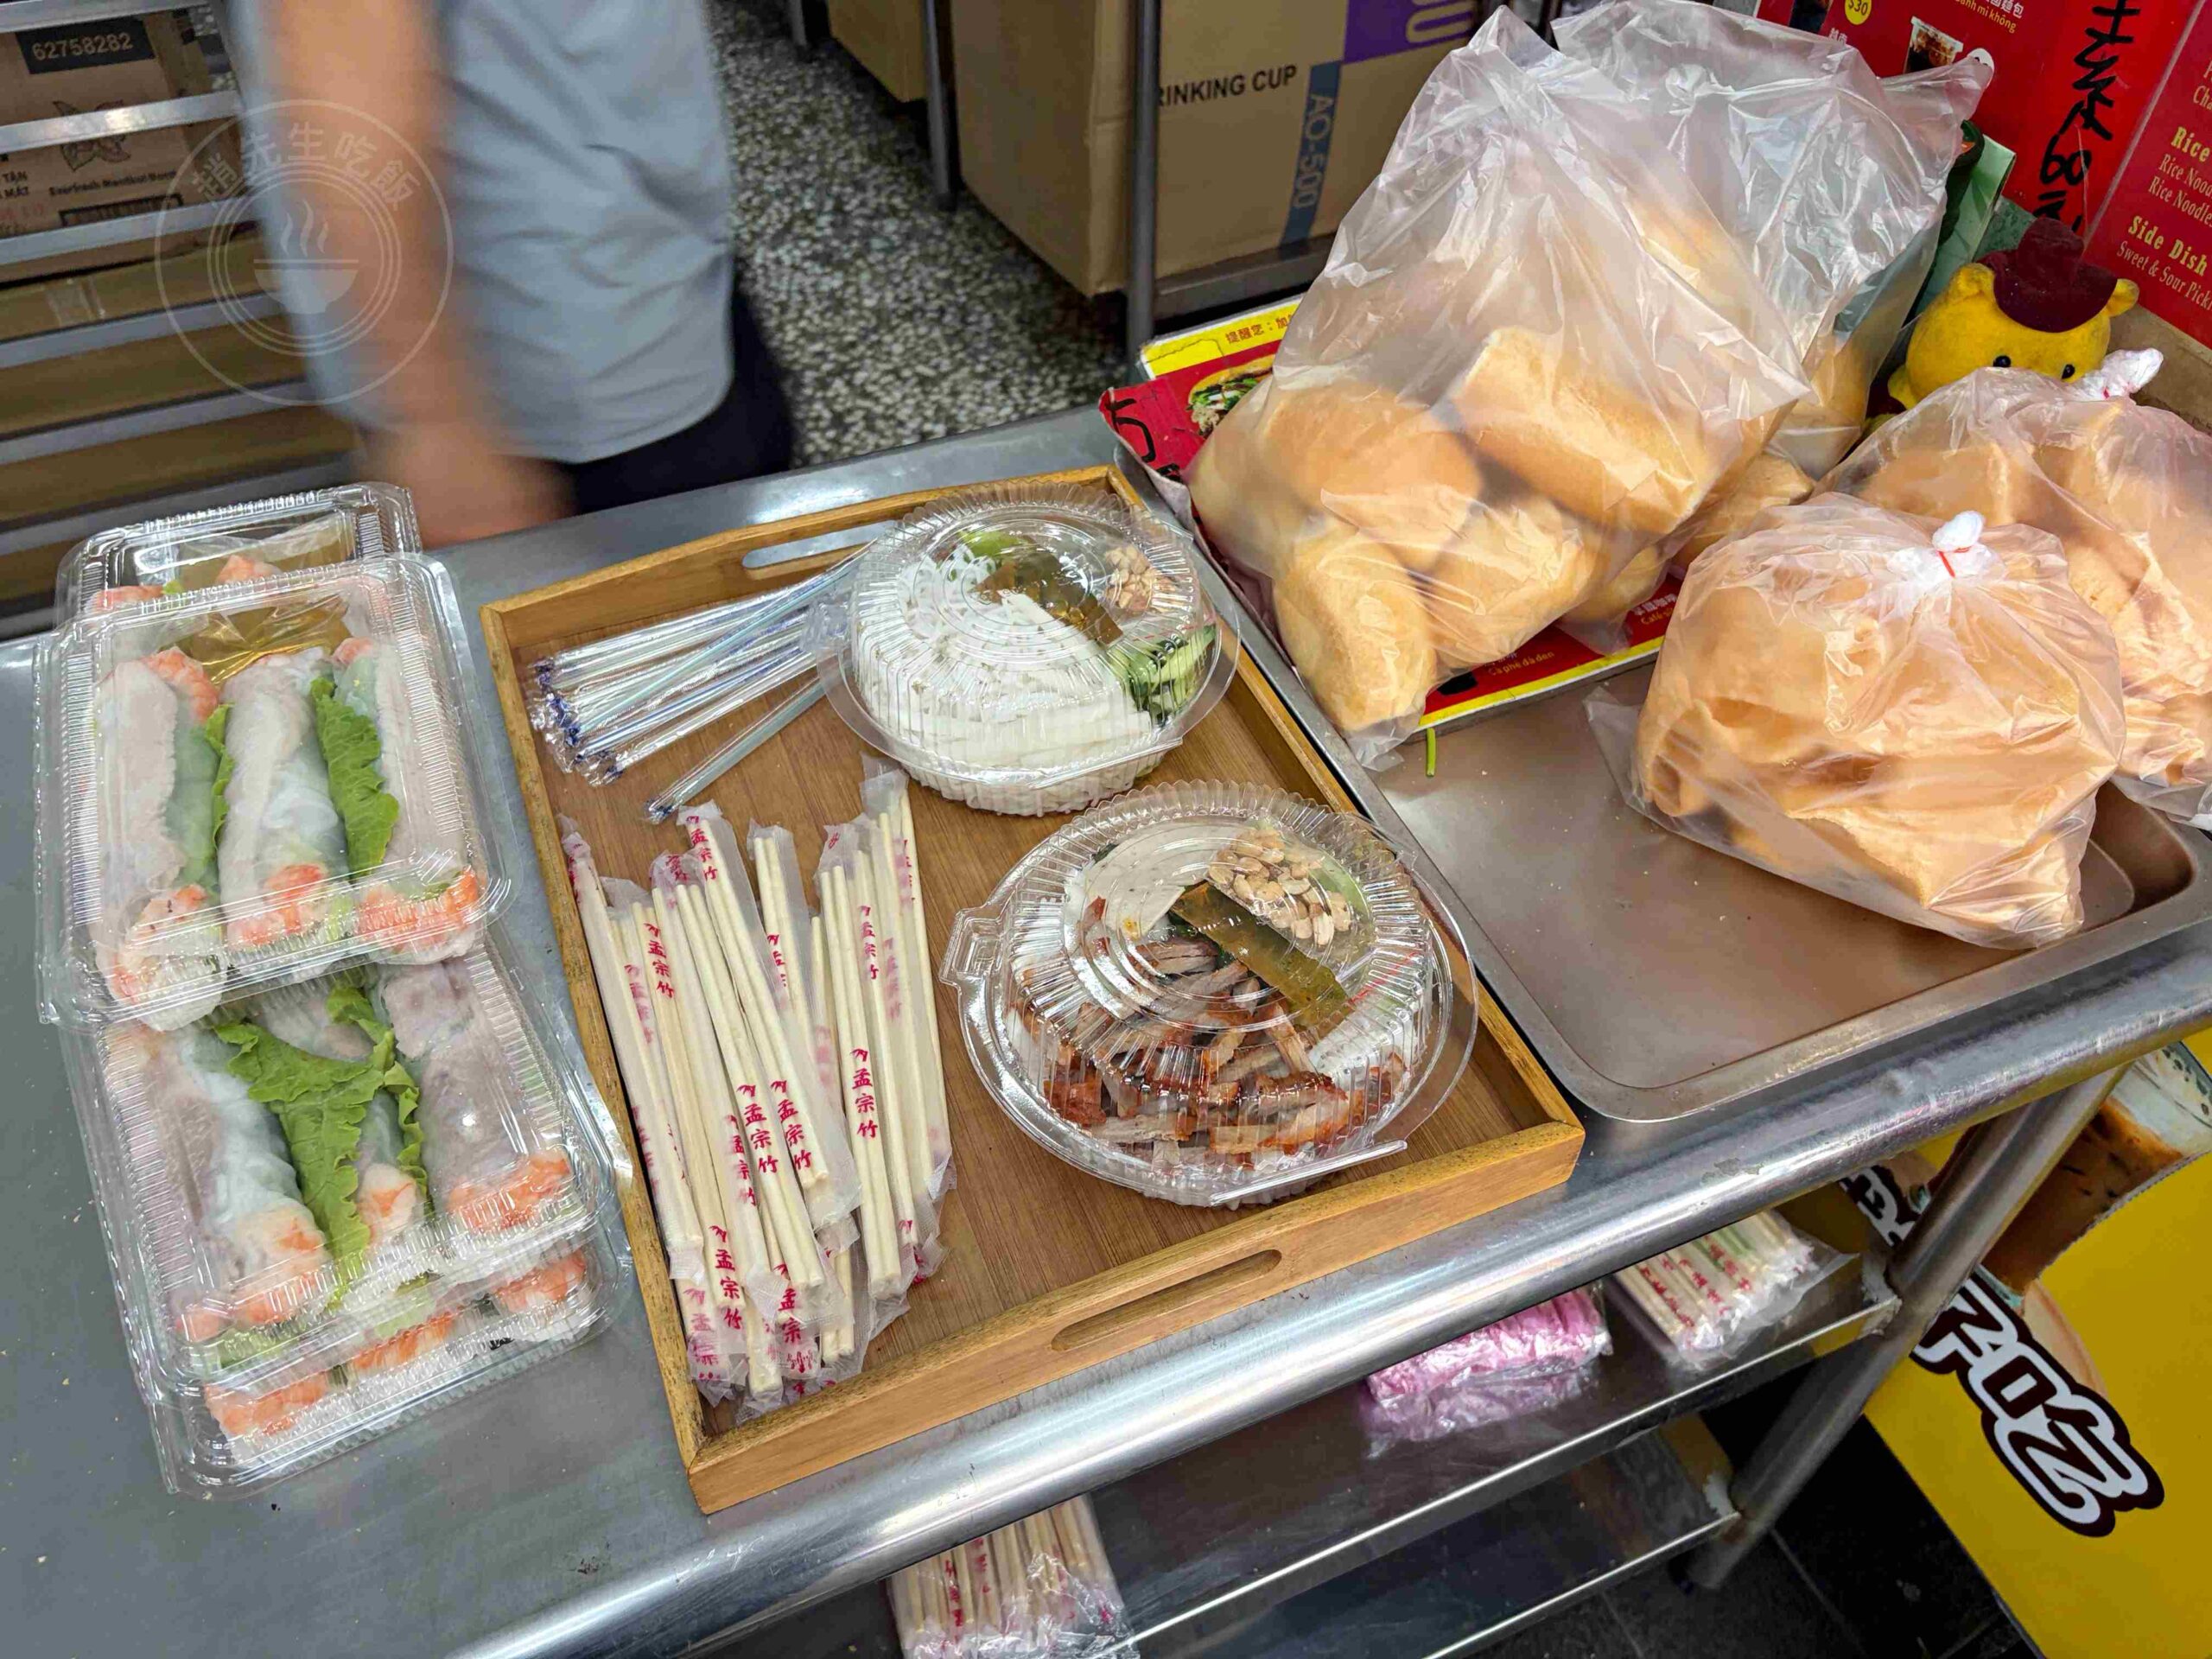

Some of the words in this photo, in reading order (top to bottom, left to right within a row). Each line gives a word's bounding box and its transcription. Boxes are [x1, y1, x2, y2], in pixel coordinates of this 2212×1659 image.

[32, 32, 133, 60] 62758282
[1253, 65, 1296, 92] CUP
[2158, 154, 2184, 181] Rice
[2171, 126, 2210, 162] Rice
[2148, 175, 2173, 203] Rice
[2117, 240, 2151, 271] Sweet
[2148, 259, 2160, 277] &
[2159, 265, 2186, 296] Sour
[2128, 215, 2164, 251] Side
[2168, 238, 2208, 276] Dish
[648, 940, 675, 998] 孟宗竹
[851, 1069, 878, 1138] 孟宗竹
[744, 1103, 779, 1173] 孟宗竹
[778, 1099, 812, 1169] 孟宗竹
[715, 1249, 742, 1330] 孟宗竹
